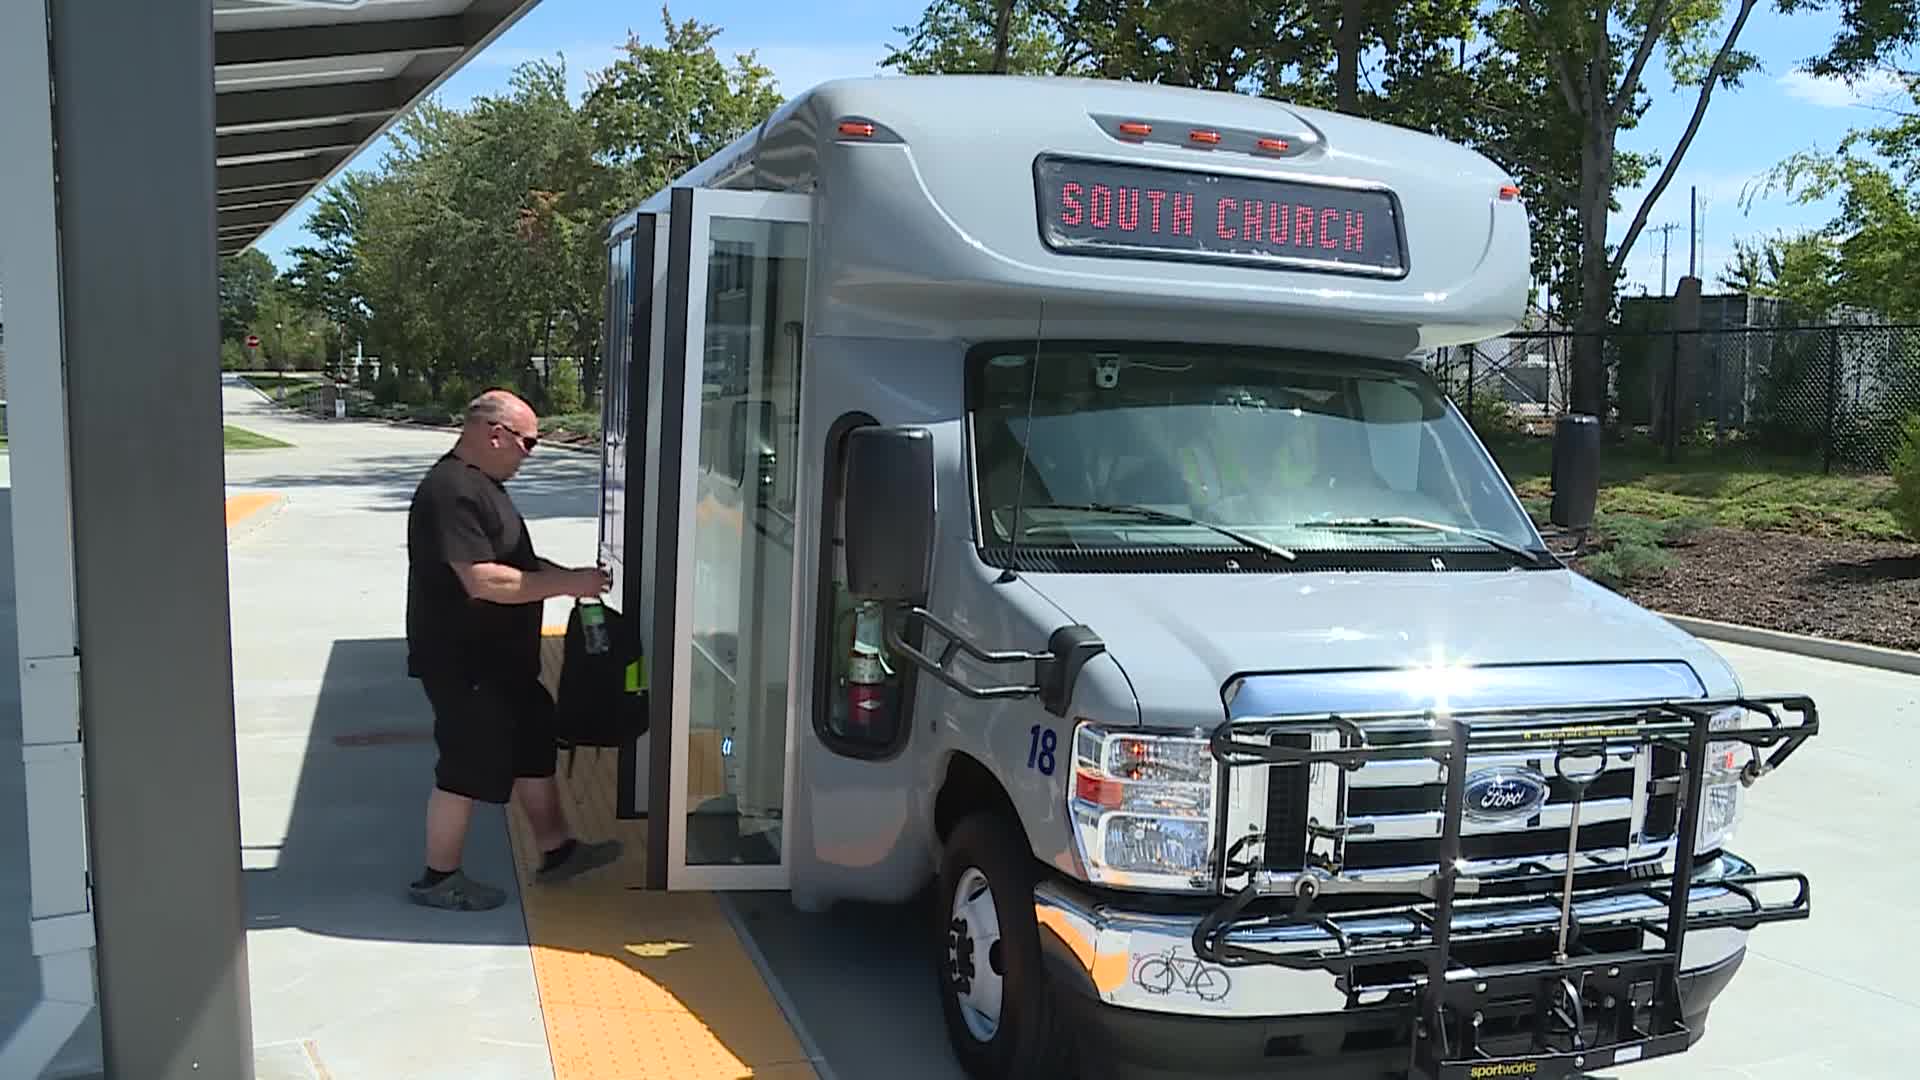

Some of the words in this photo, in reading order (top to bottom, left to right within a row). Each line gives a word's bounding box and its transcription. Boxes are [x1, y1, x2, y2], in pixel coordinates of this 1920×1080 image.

[1061, 182, 1193, 236] SOUTH
[1216, 197, 1365, 252] CHURCH
[1027, 724, 1057, 776] 18
[1481, 783, 1526, 808] Ford
[1470, 1061, 1537, 1078] sportworks
